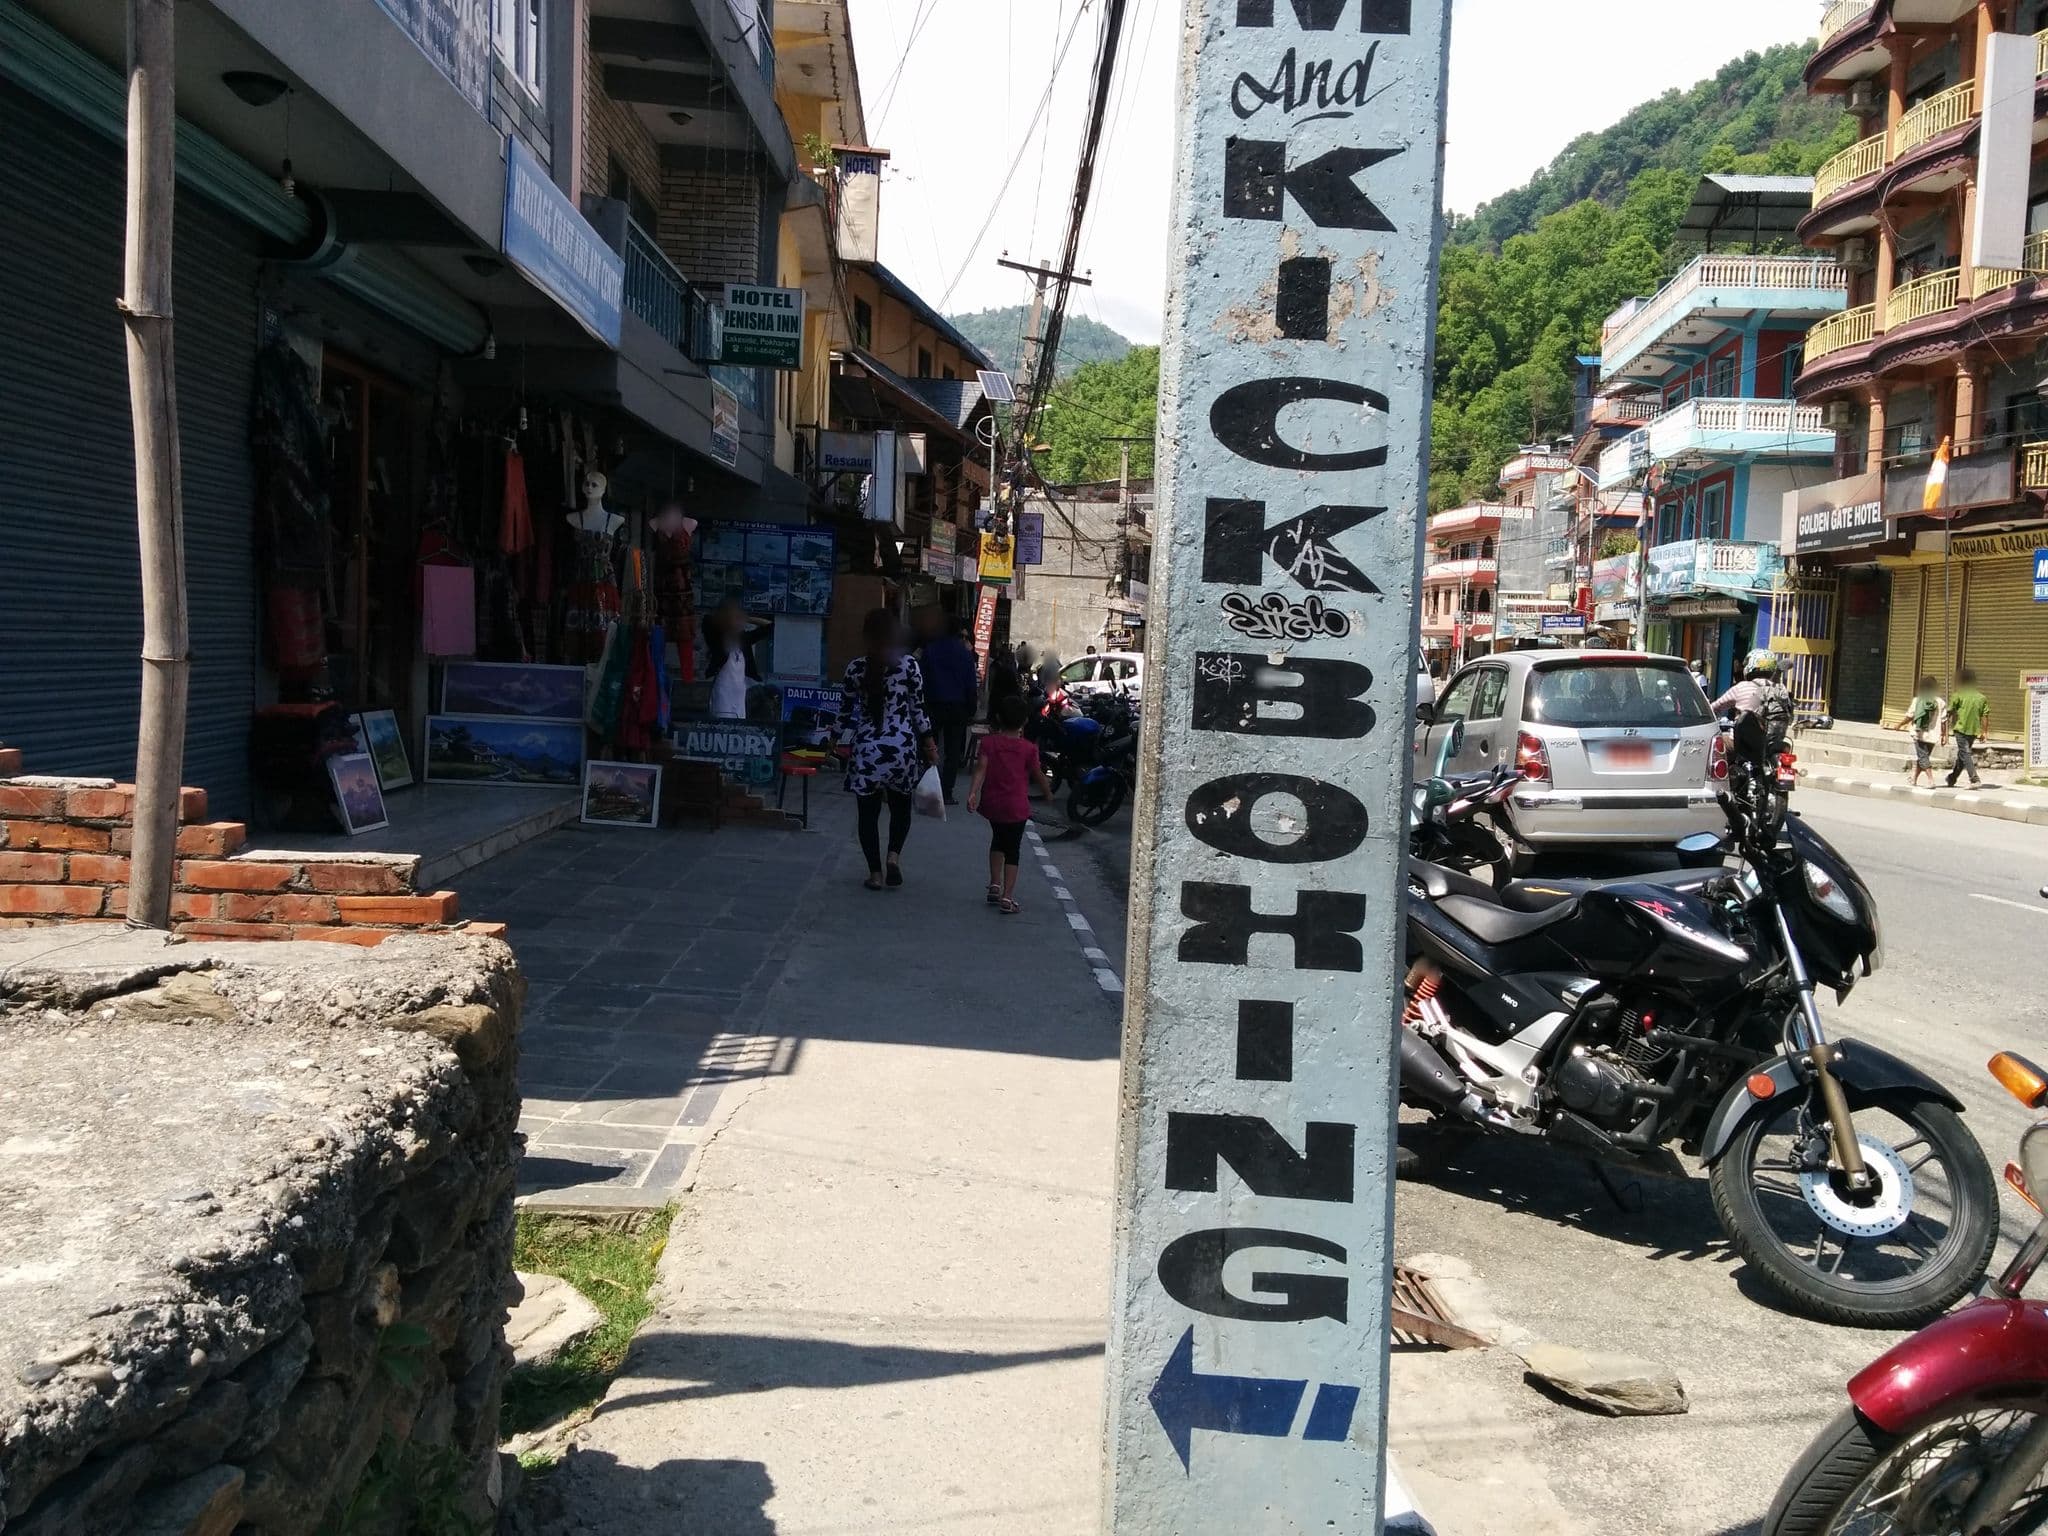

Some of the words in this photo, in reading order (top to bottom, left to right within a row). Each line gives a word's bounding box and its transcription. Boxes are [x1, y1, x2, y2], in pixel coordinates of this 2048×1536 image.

[1231, 40, 1405, 119] And
[845, 157, 876, 174] HOTEL
[513, 163, 552, 243] HERITAGE
[731, 289, 793, 309] HOTEL
[723, 310, 774, 332] JENISHA
[777, 314, 799, 334] INN
[734, 520, 777, 530] Services
[1799, 511, 1830, 537] GOLDEN
[1831, 506, 1853, 531] GATE
[1854, 501, 1882, 527] HOTEL
[1516, 604, 1536, 613] HOTEL
[787, 688, 815, 700] DAILY
[816, 690, 842, 701] TOUR
[1157, 135, 1405, 1324] KICKBOXING
[672, 731, 777, 756] LAUNDRY
